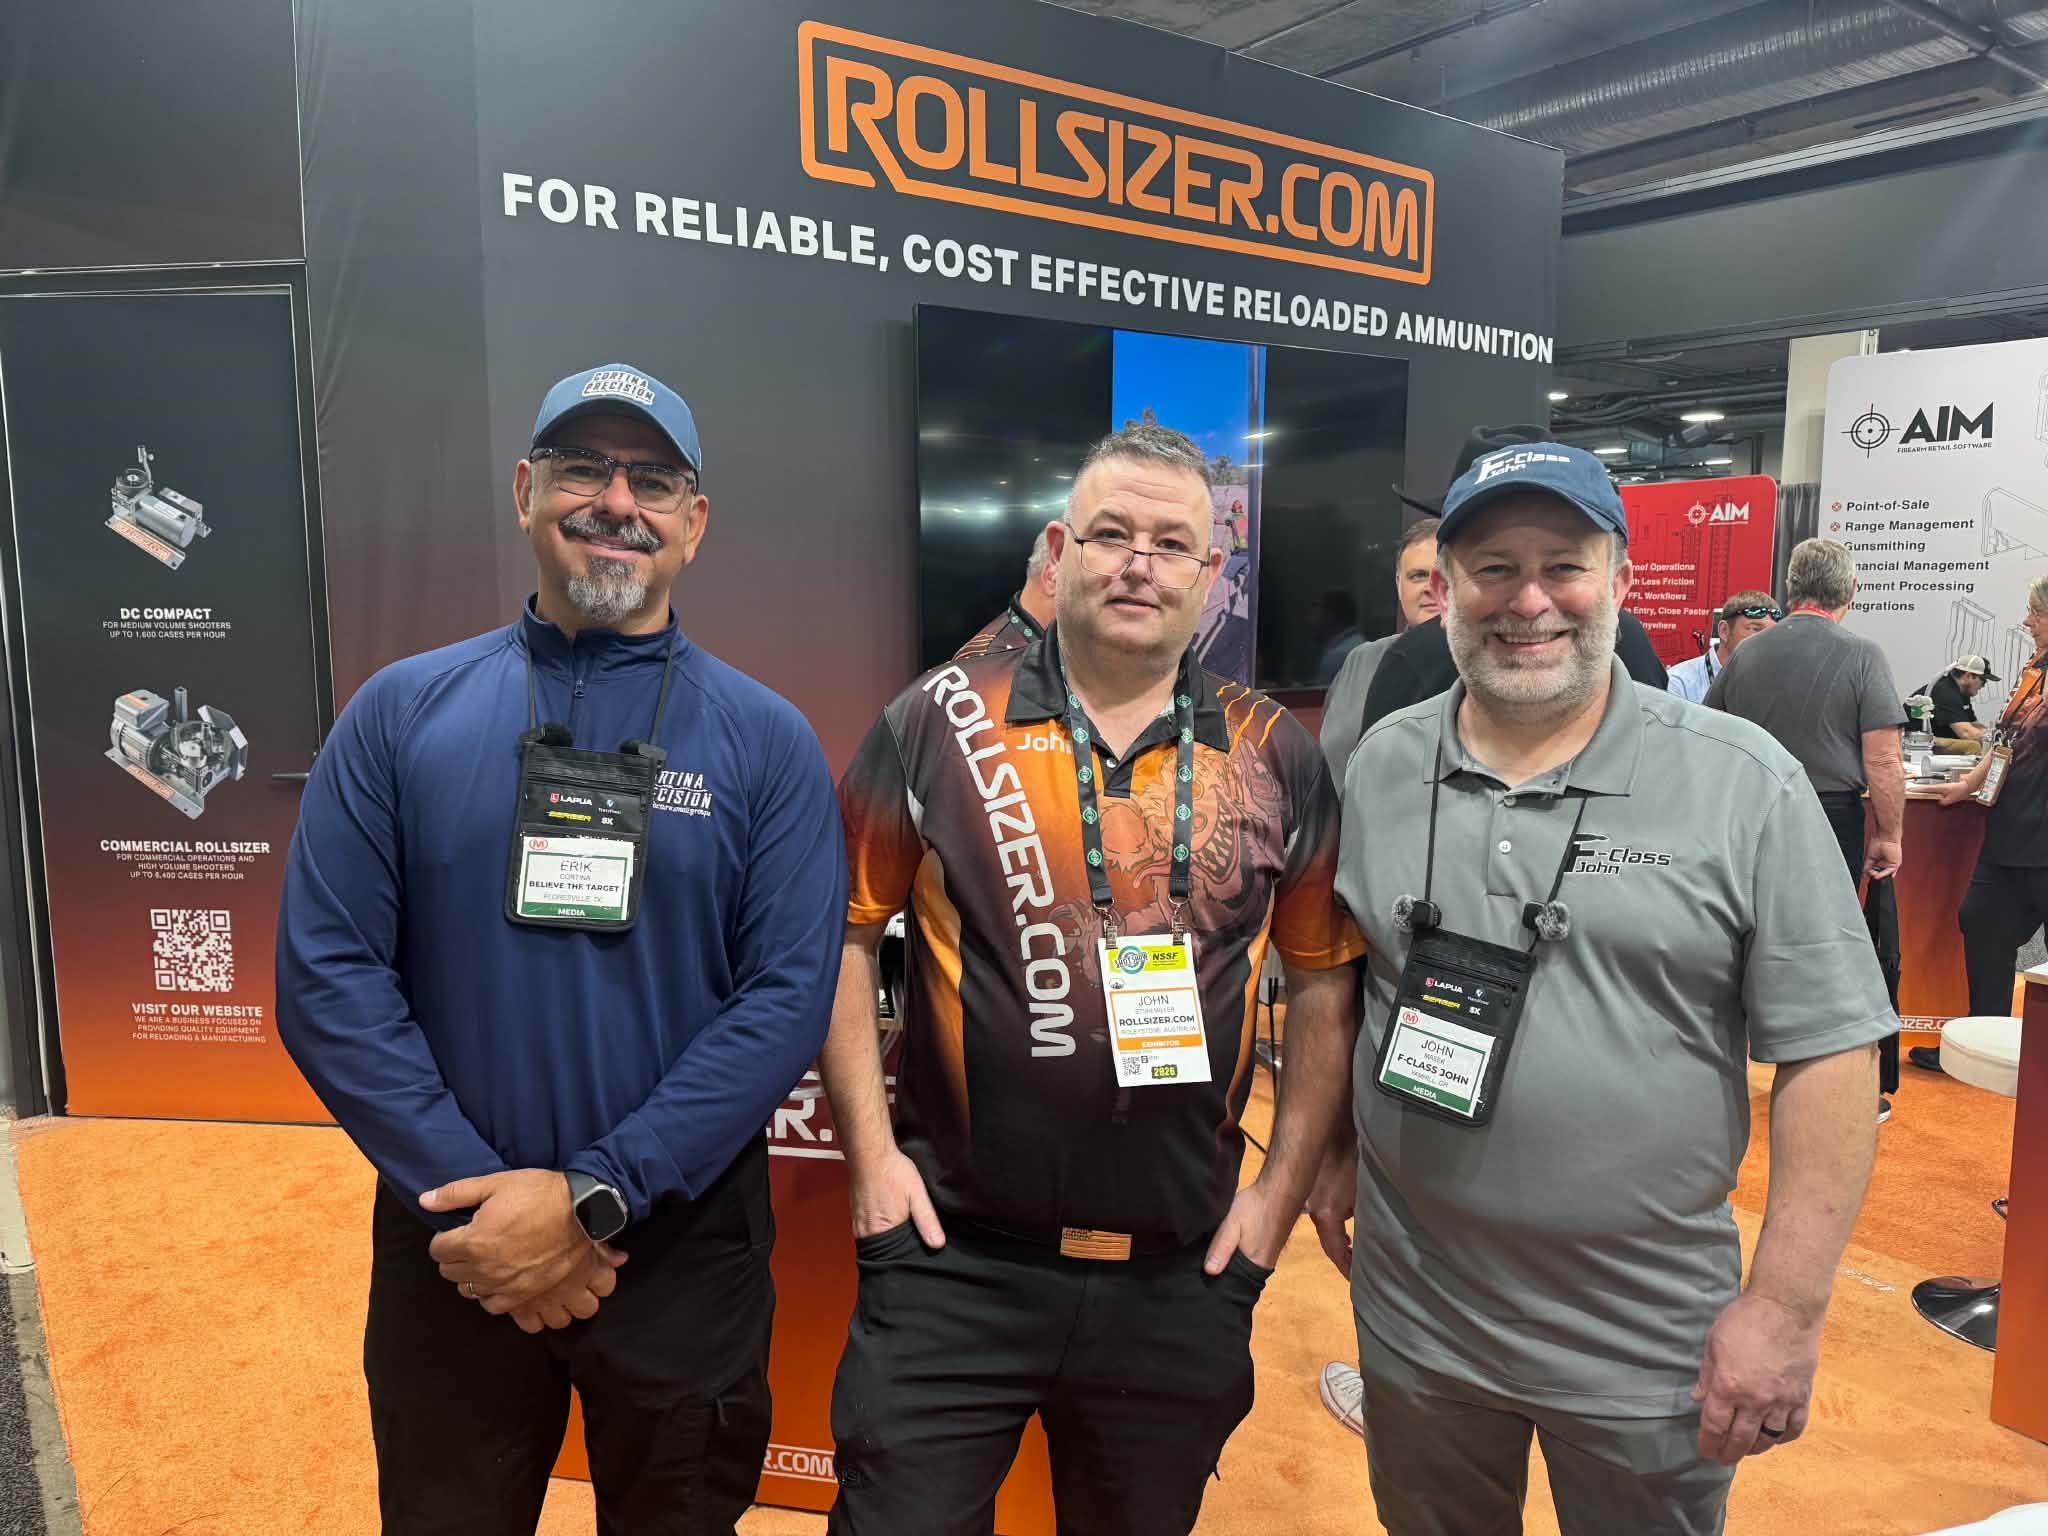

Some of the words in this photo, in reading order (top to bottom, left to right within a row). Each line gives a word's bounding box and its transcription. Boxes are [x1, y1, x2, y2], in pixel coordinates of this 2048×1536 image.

[826, 55, 1418, 261] ROLLSIZER.COM
[502, 171, 620, 230] FOR
[635, 191, 890, 273] RELIABLE,
[902, 233, 1018, 287] COST
[1030, 253, 1225, 317] EFFECTIVE
[1234, 287, 1388, 338] RELOADED
[1395, 311, 1554, 364] AMMUNITION
[594, 372, 647, 388] CORTINA
[583, 381, 653, 400] PRECISION
[1899, 401, 1994, 444] AIM
[1953, 442, 1992, 450] SOFTWARE
[1710, 502, 1749, 520] AIM
[1847, 500, 1930, 511] Point-of-Sale
[1845, 521, 1885, 532] Range
[1889, 519, 1974, 532] Management
[1651, 563, 1696, 572] Operations
[1855, 561, 1899, 571] nancial
[1904, 560, 1989, 572] Management
[1663, 577, 1695, 585] Friction
[1857, 582, 1895, 593] yment
[1900, 581, 1974, 592] Processing
[1645, 592, 1687, 600] Workflows
[1634, 607, 1657, 616] Entry,
[1658, 607, 1682, 615] Close
[1684, 608, 1710, 616] Faster
[1847, 601, 1915, 612] tegrations
[120, 608, 140, 619] DC
[144, 608, 211, 619] COMPACT
[103, 621, 119, 629] FOR
[121, 621, 152, 629] MEDIUM
[154, 621, 187, 629] VOLUME
[188, 621, 231, 629] SHOOTERS
[1641, 622, 1677, 630] nywhere
[658, 770, 703, 789] RTINA
[560, 795, 593, 806] LAPUA
[657, 788, 712, 809] CISION
[100, 840, 192, 852] COMMERCIAL
[195, 841, 271, 853] ROLLSIZER
[134, 854, 185, 862] COMMERCIAL
[922, 665, 1077, 1058] ROLLSIZER.COM
[560, 861, 592, 872] ERIK
[1576, 861, 1620, 875] John
[142, 871, 153, 879] TO
[178, 872, 203, 880] CASES
[529, 881, 564, 890] BELIEVE
[567, 883, 585, 891] THE
[586, 884, 620, 893] TARGET
[558, 907, 585, 917] MEDIA
[1152, 952, 1178, 960] NSSF
[1434, 980, 1463, 993] LAPUA
[1138, 995, 1169, 1007] JOHN
[132, 1003, 168, 1015] VISIT
[171, 1004, 200, 1016] OUR
[202, 1005, 263, 1017] WEBSITE
[172, 1017, 210, 1025] BUSINESS
[212, 1018, 247, 1026] FOCUSED
[1119, 1015, 1195, 1027] ROLLSIZER.COM
[138, 1024, 178, 1032] PROVIDING
[180, 1025, 213, 1033] QUALITY
[216, 1026, 259, 1034] EQUIPMENT
[149, 1033, 192, 1041] RELOADING
[201, 1035, 266, 1044] MANUFACTURING
[1421, 1039, 1454, 1058] JOHN
[1398, 1053, 1438, 1074] F-CLASS
[1440, 1070, 1469, 1086] JOHN
[1413, 1085, 1437, 1099] MEDIA
